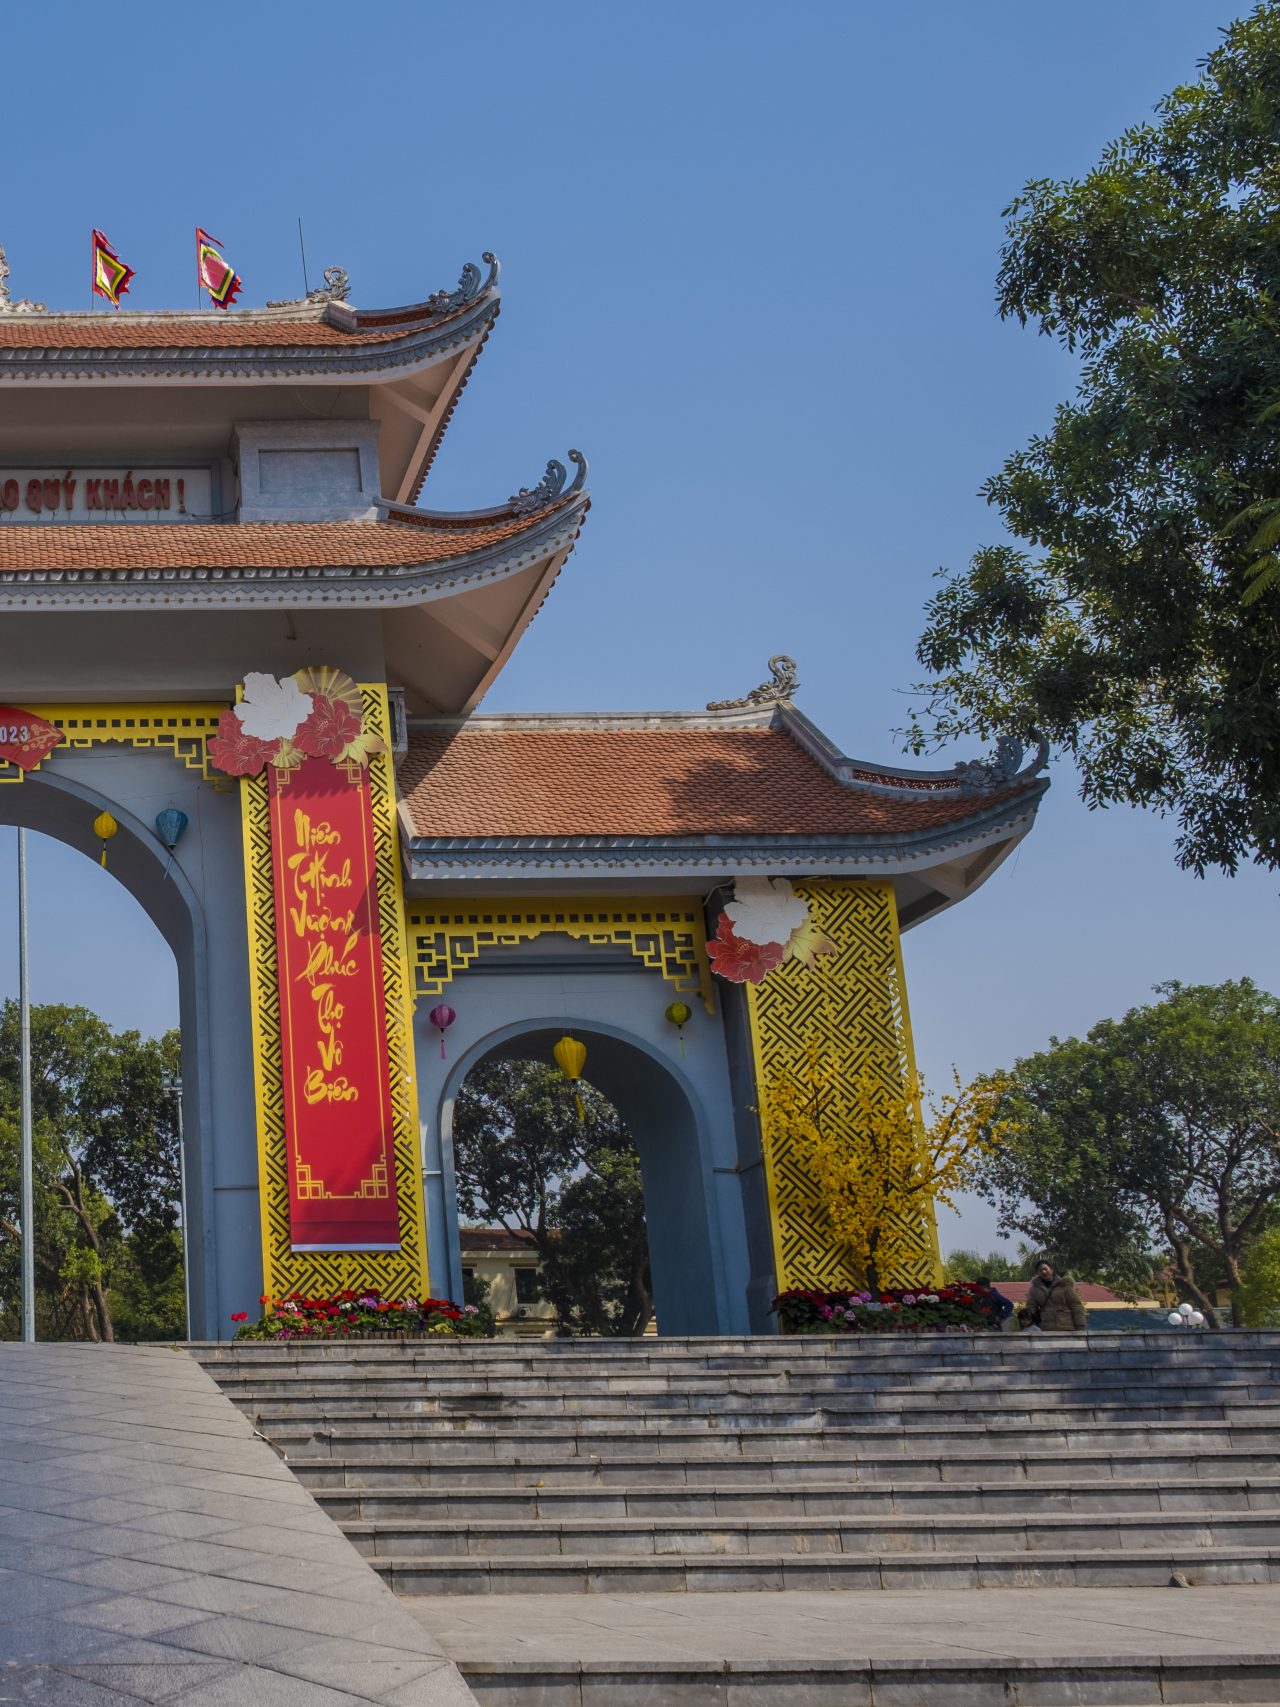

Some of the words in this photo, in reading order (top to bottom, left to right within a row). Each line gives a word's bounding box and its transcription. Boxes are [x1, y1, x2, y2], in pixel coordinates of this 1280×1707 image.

[26, 471, 76, 513] QUÝ
[86, 471, 170, 511] KHÁCH
[294, 808, 341, 851] Niên
[288, 850, 352, 906] Thịnh
[290, 903, 363, 954] Vượng
[295, 934, 360, 986] Phúc
[311, 983, 345, 1033] Thọ
[317, 1027, 344, 1071] Vô
[304, 1065, 359, 1105] Biên
